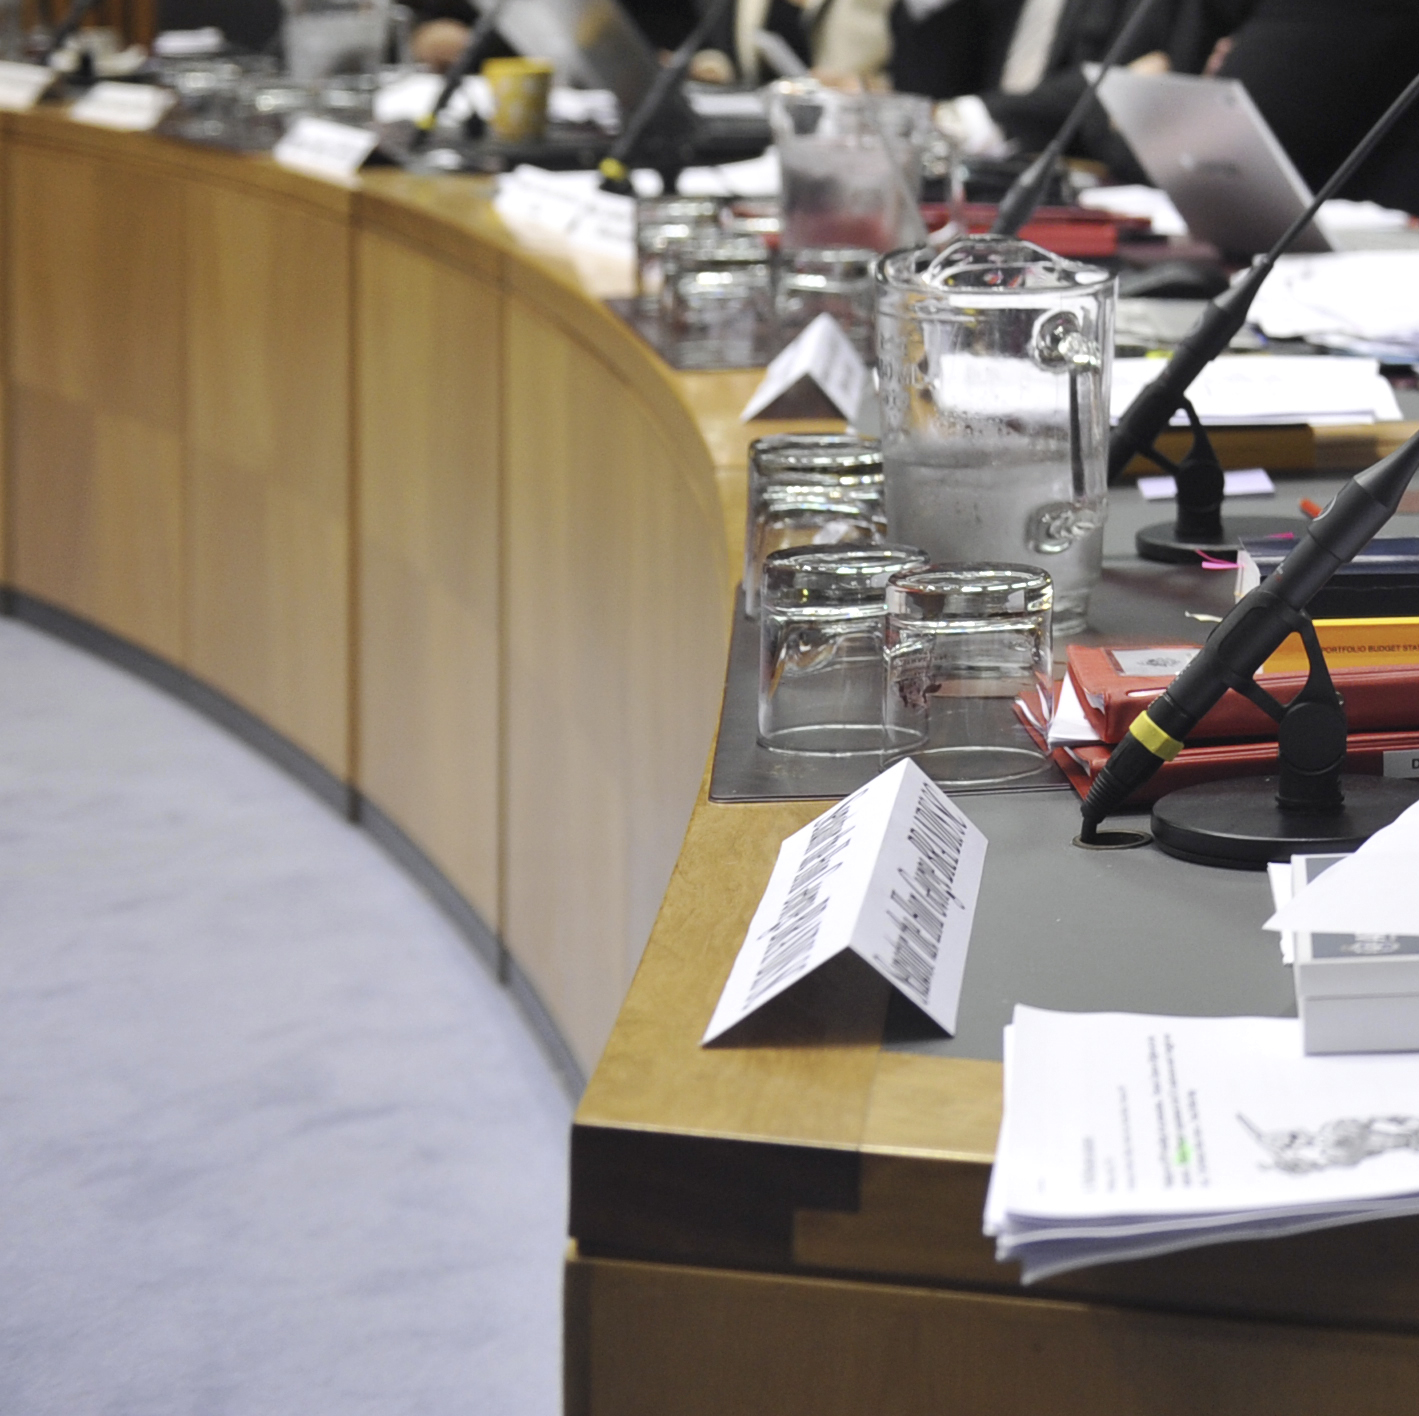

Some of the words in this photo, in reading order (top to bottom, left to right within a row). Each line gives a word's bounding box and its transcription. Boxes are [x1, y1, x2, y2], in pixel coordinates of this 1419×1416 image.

[1321, 644, 1367, 654] PORTFOLIO
[1368, 644, 1401, 653] BUDGET
[907, 796, 964, 884] BRANDIS
